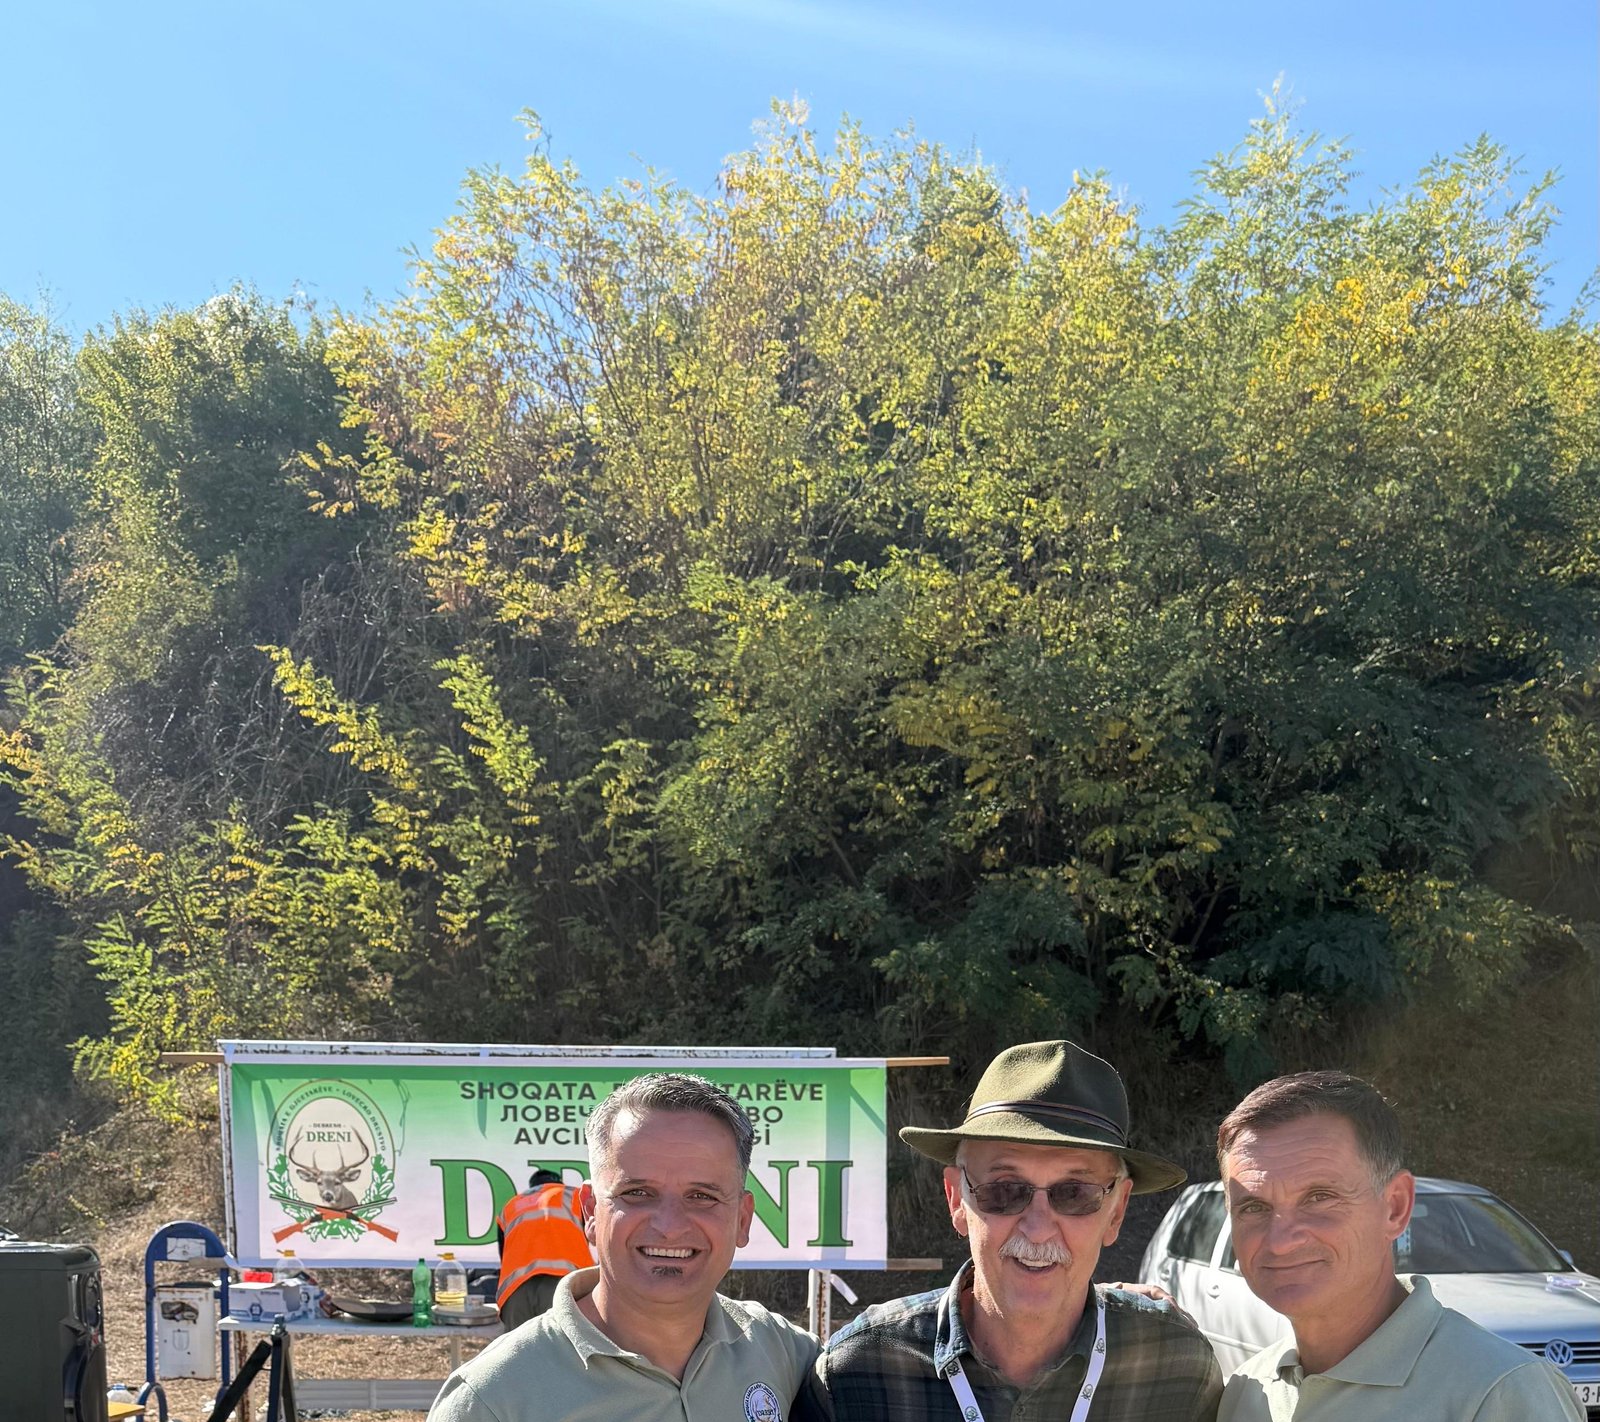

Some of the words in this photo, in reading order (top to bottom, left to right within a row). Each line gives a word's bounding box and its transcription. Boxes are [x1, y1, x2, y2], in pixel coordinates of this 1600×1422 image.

[460, 1081, 597, 1101] SHOQATA
[722, 1079, 823, 1101] TARËVE
[306, 1131, 352, 1143] DRENI
